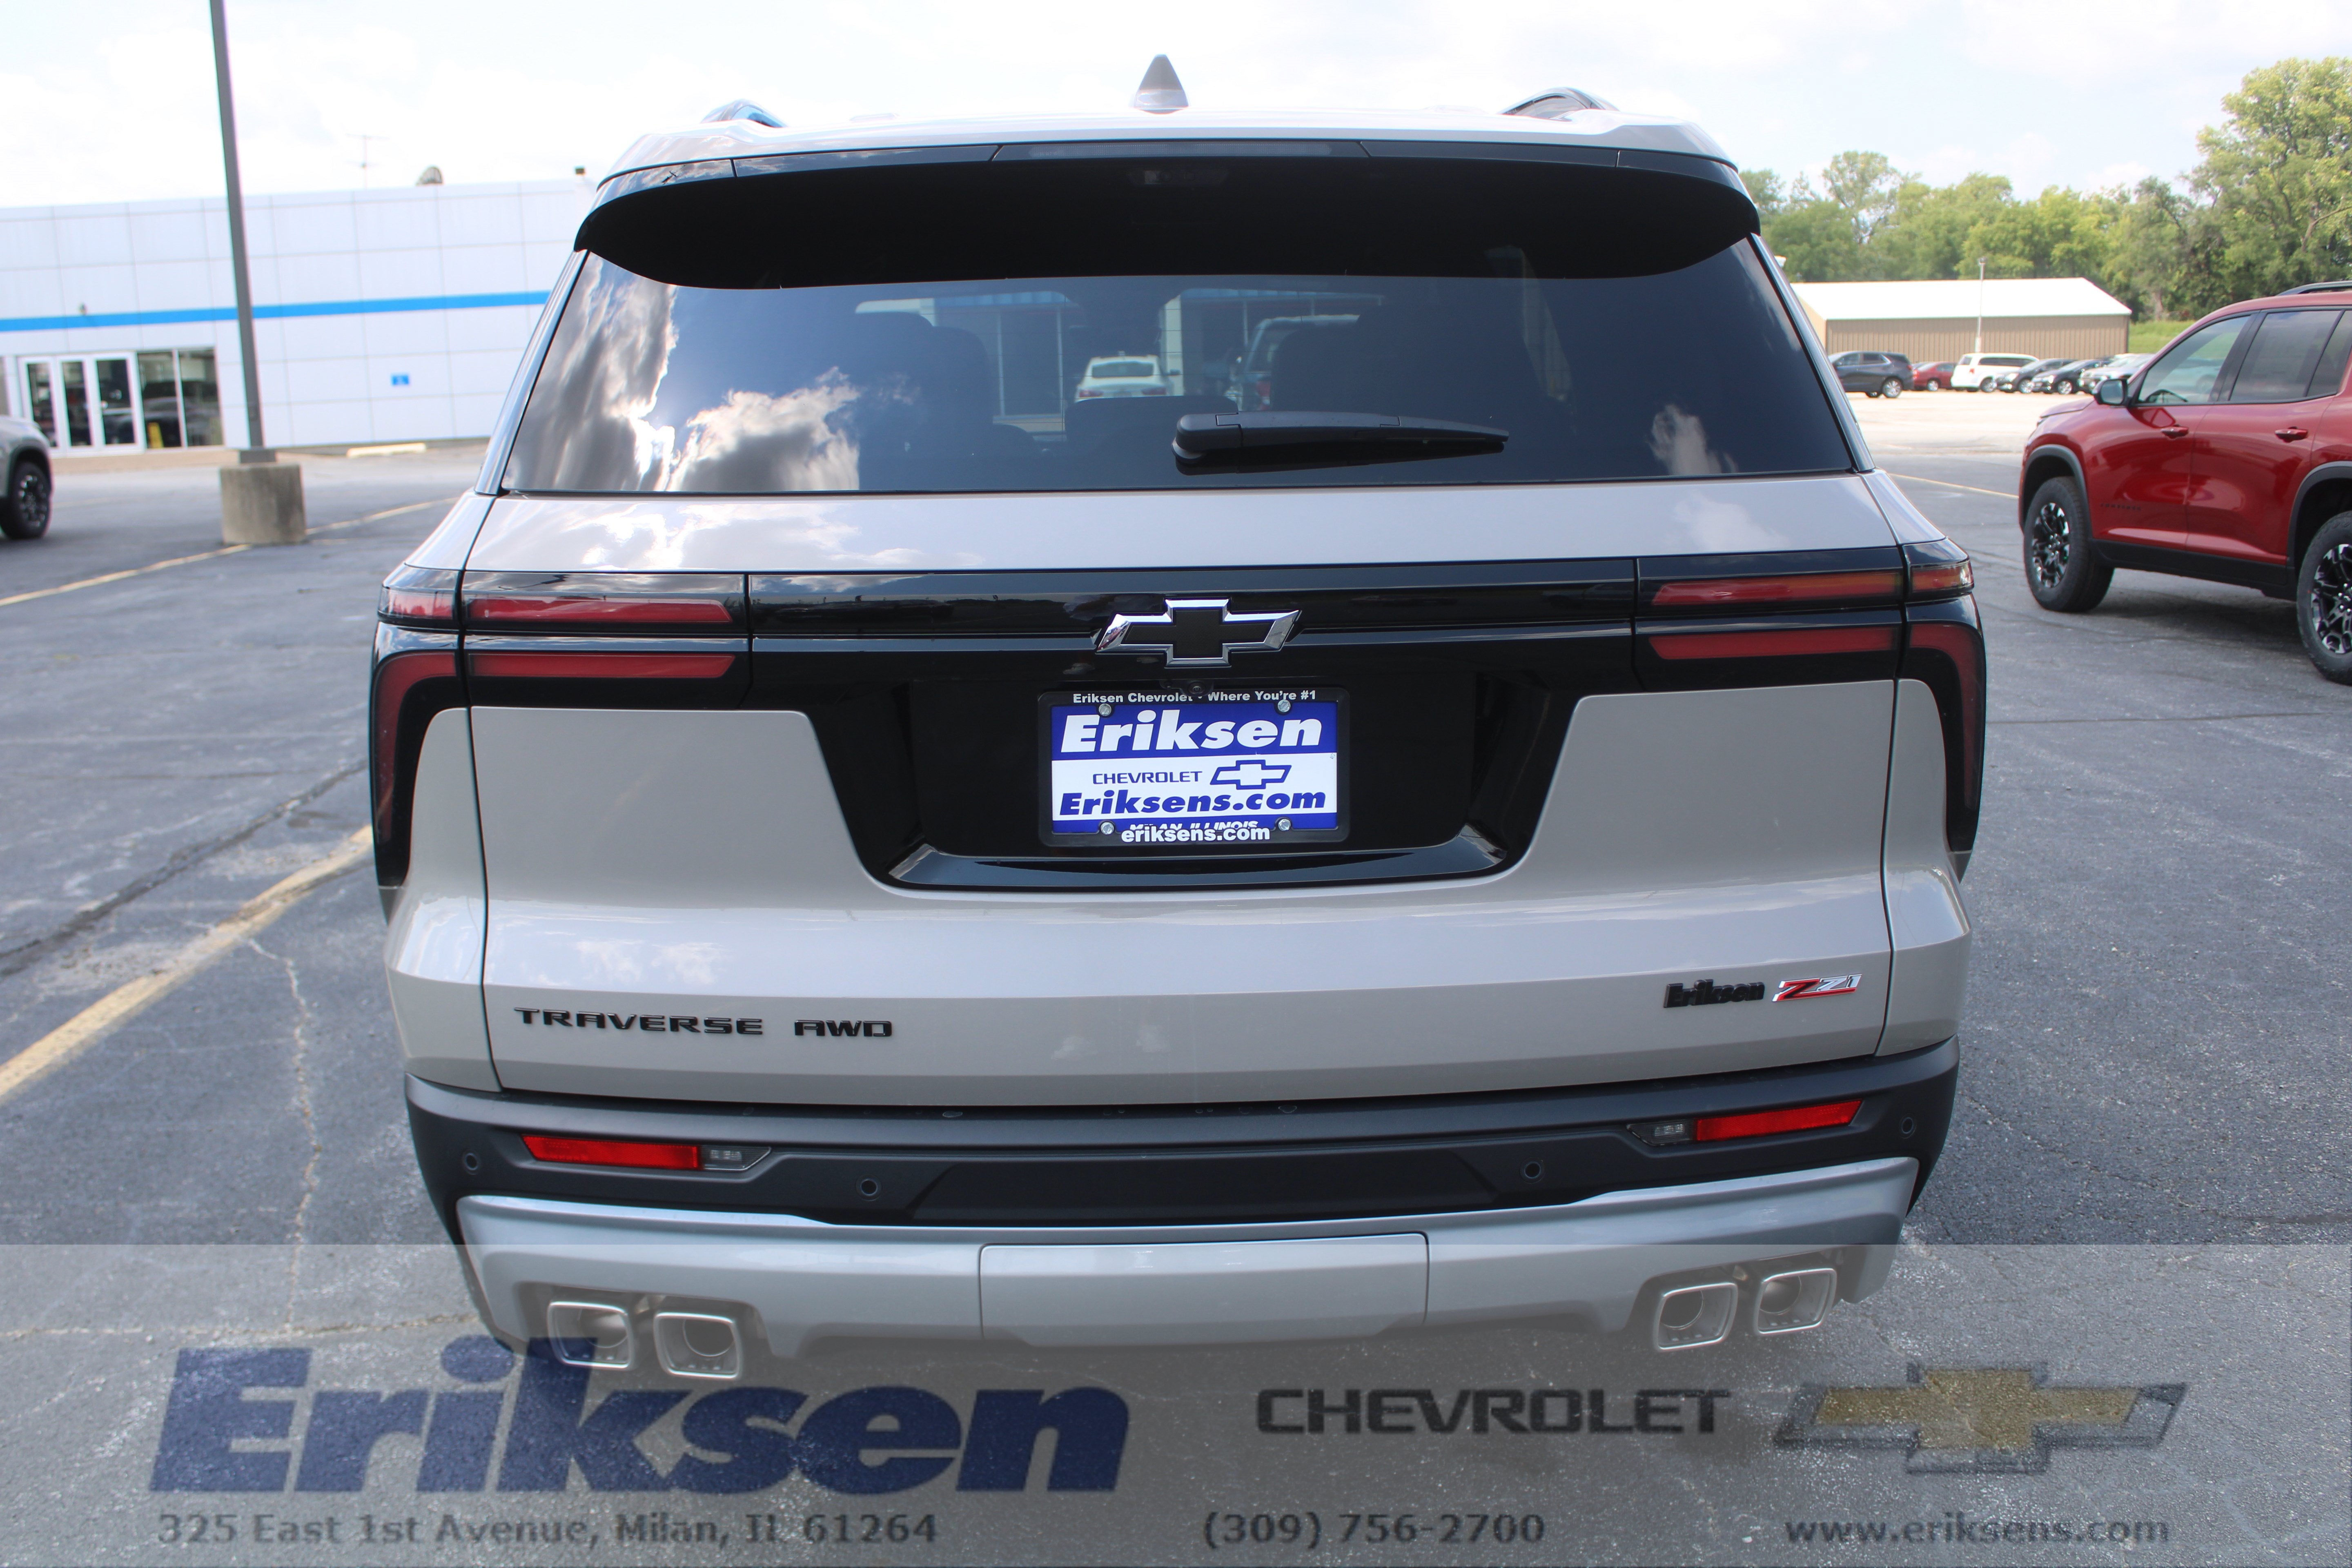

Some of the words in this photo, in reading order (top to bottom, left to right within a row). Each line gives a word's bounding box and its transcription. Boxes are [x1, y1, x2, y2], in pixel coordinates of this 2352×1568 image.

[1073, 693, 1123, 703] Eriksen
[1127, 693, 1193, 702] Chevrolet
[1207, 691, 1250, 701] Where
[1254, 690, 1297, 700] You're
[1300, 690, 1316, 700] #1
[1061, 709, 1322, 753] Eriksen
[1093, 771, 1203, 784] CHEVROLET
[1059, 789, 1326, 815] Eriksens.com
[1121, 826, 1270, 842] eriksens.com
[1663, 979, 1765, 1008] Eriksen
[513, 1007, 763, 1035] TRAVERSE
[793, 1019, 893, 1037] AWD
